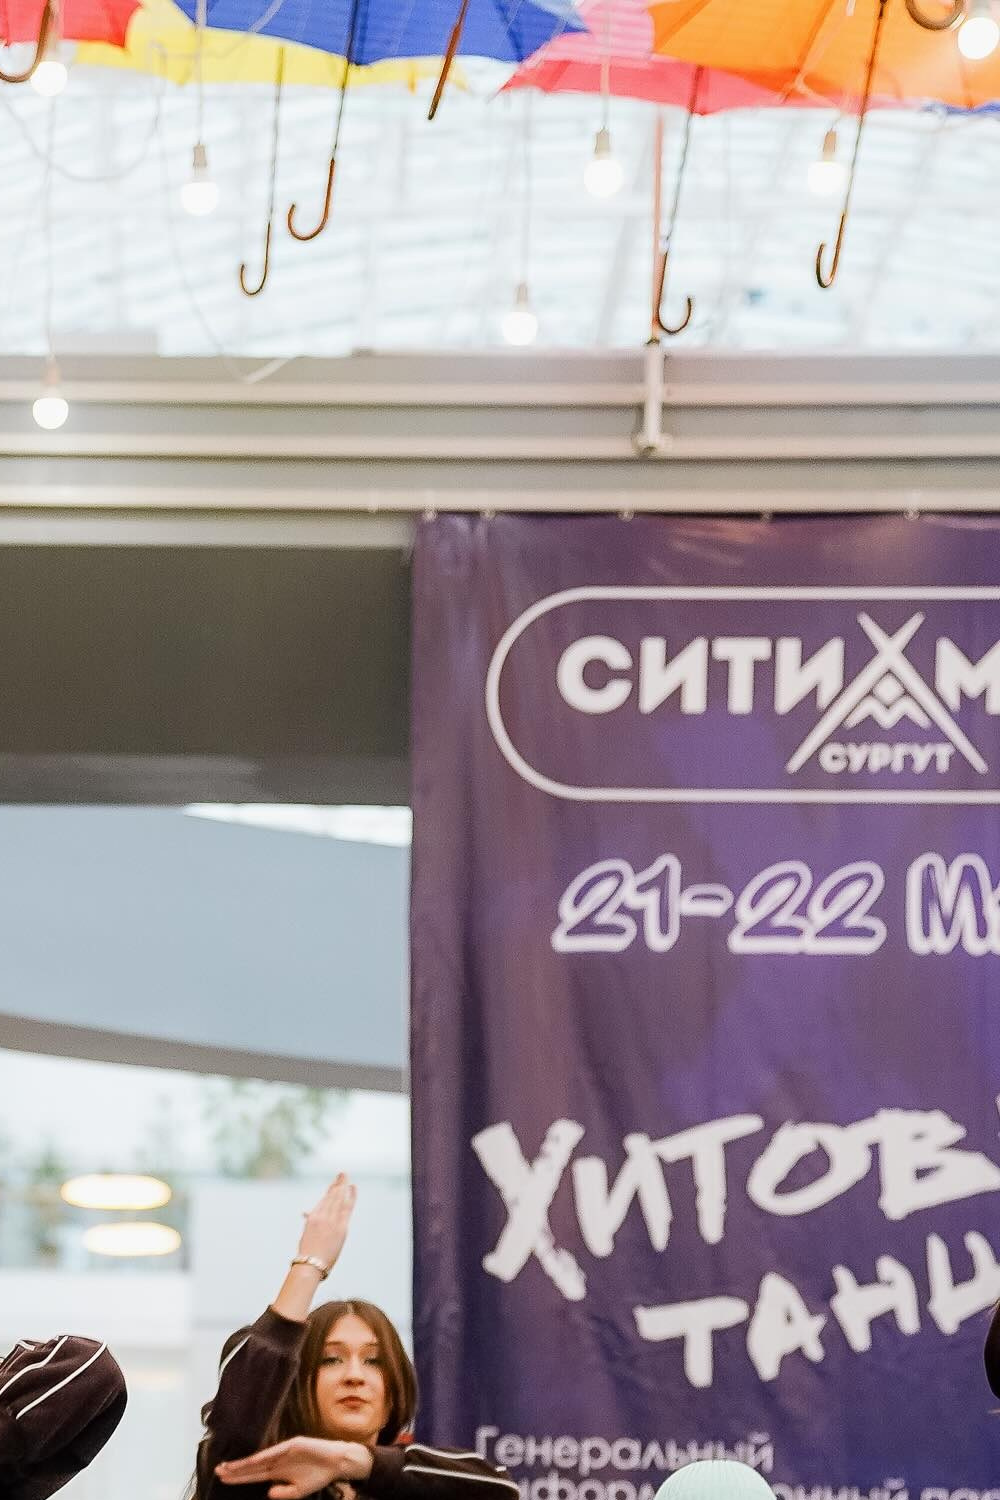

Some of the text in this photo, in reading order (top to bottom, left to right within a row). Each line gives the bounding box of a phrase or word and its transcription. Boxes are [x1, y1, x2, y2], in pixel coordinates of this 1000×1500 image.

[818, 741, 956, 774] СУРГУТ
[551, 852, 888, 955] 21-22
[470, 1106, 1000, 1302] ХИТОВ
